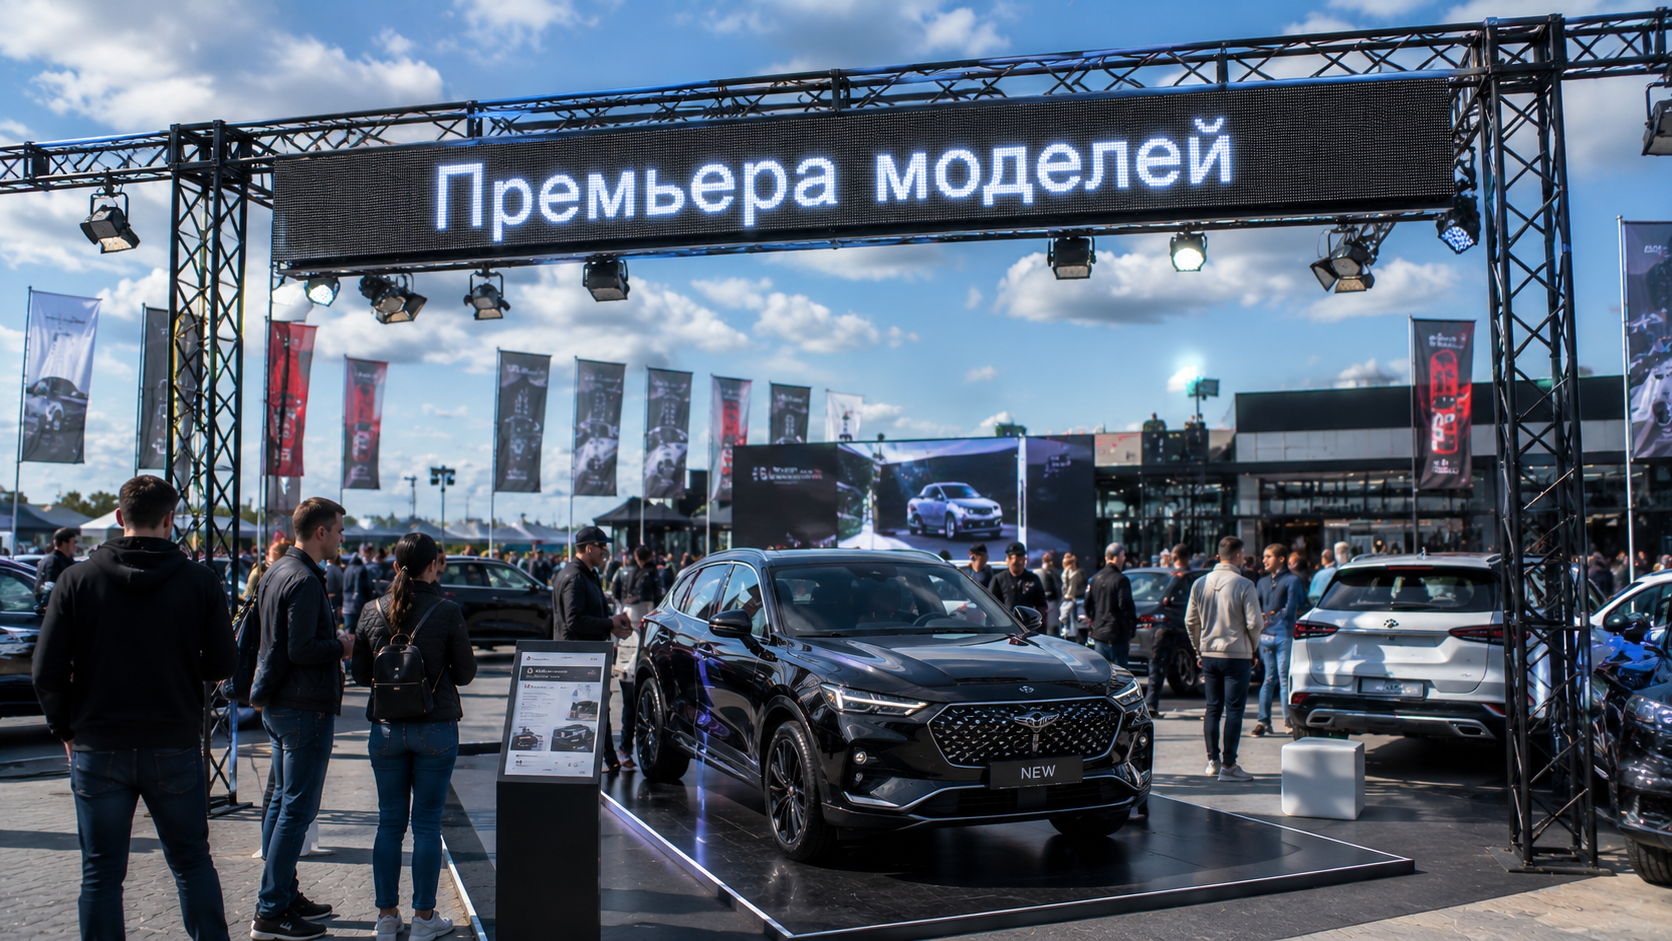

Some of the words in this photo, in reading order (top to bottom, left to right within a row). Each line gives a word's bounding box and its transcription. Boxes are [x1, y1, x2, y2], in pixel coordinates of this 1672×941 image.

[436, 157, 838, 242] Премьера
[876, 117, 1231, 206] моделей
[1021, 765, 1056, 779] NEW
